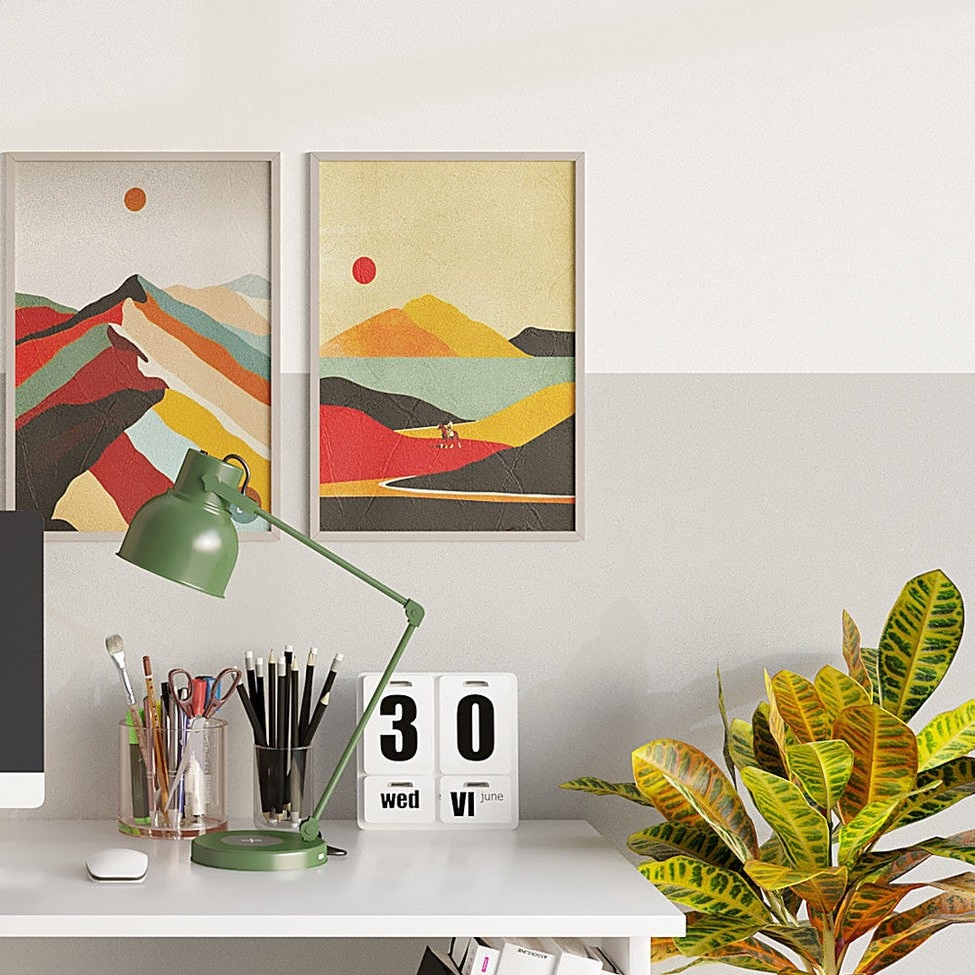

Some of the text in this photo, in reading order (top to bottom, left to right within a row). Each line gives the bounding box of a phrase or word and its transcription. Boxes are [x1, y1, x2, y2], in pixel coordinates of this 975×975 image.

[380, 694, 495, 762] 3 0
[380, 790, 420, 809] wed
[450, 791, 475, 817] VI
[480, 792, 504, 803] june
